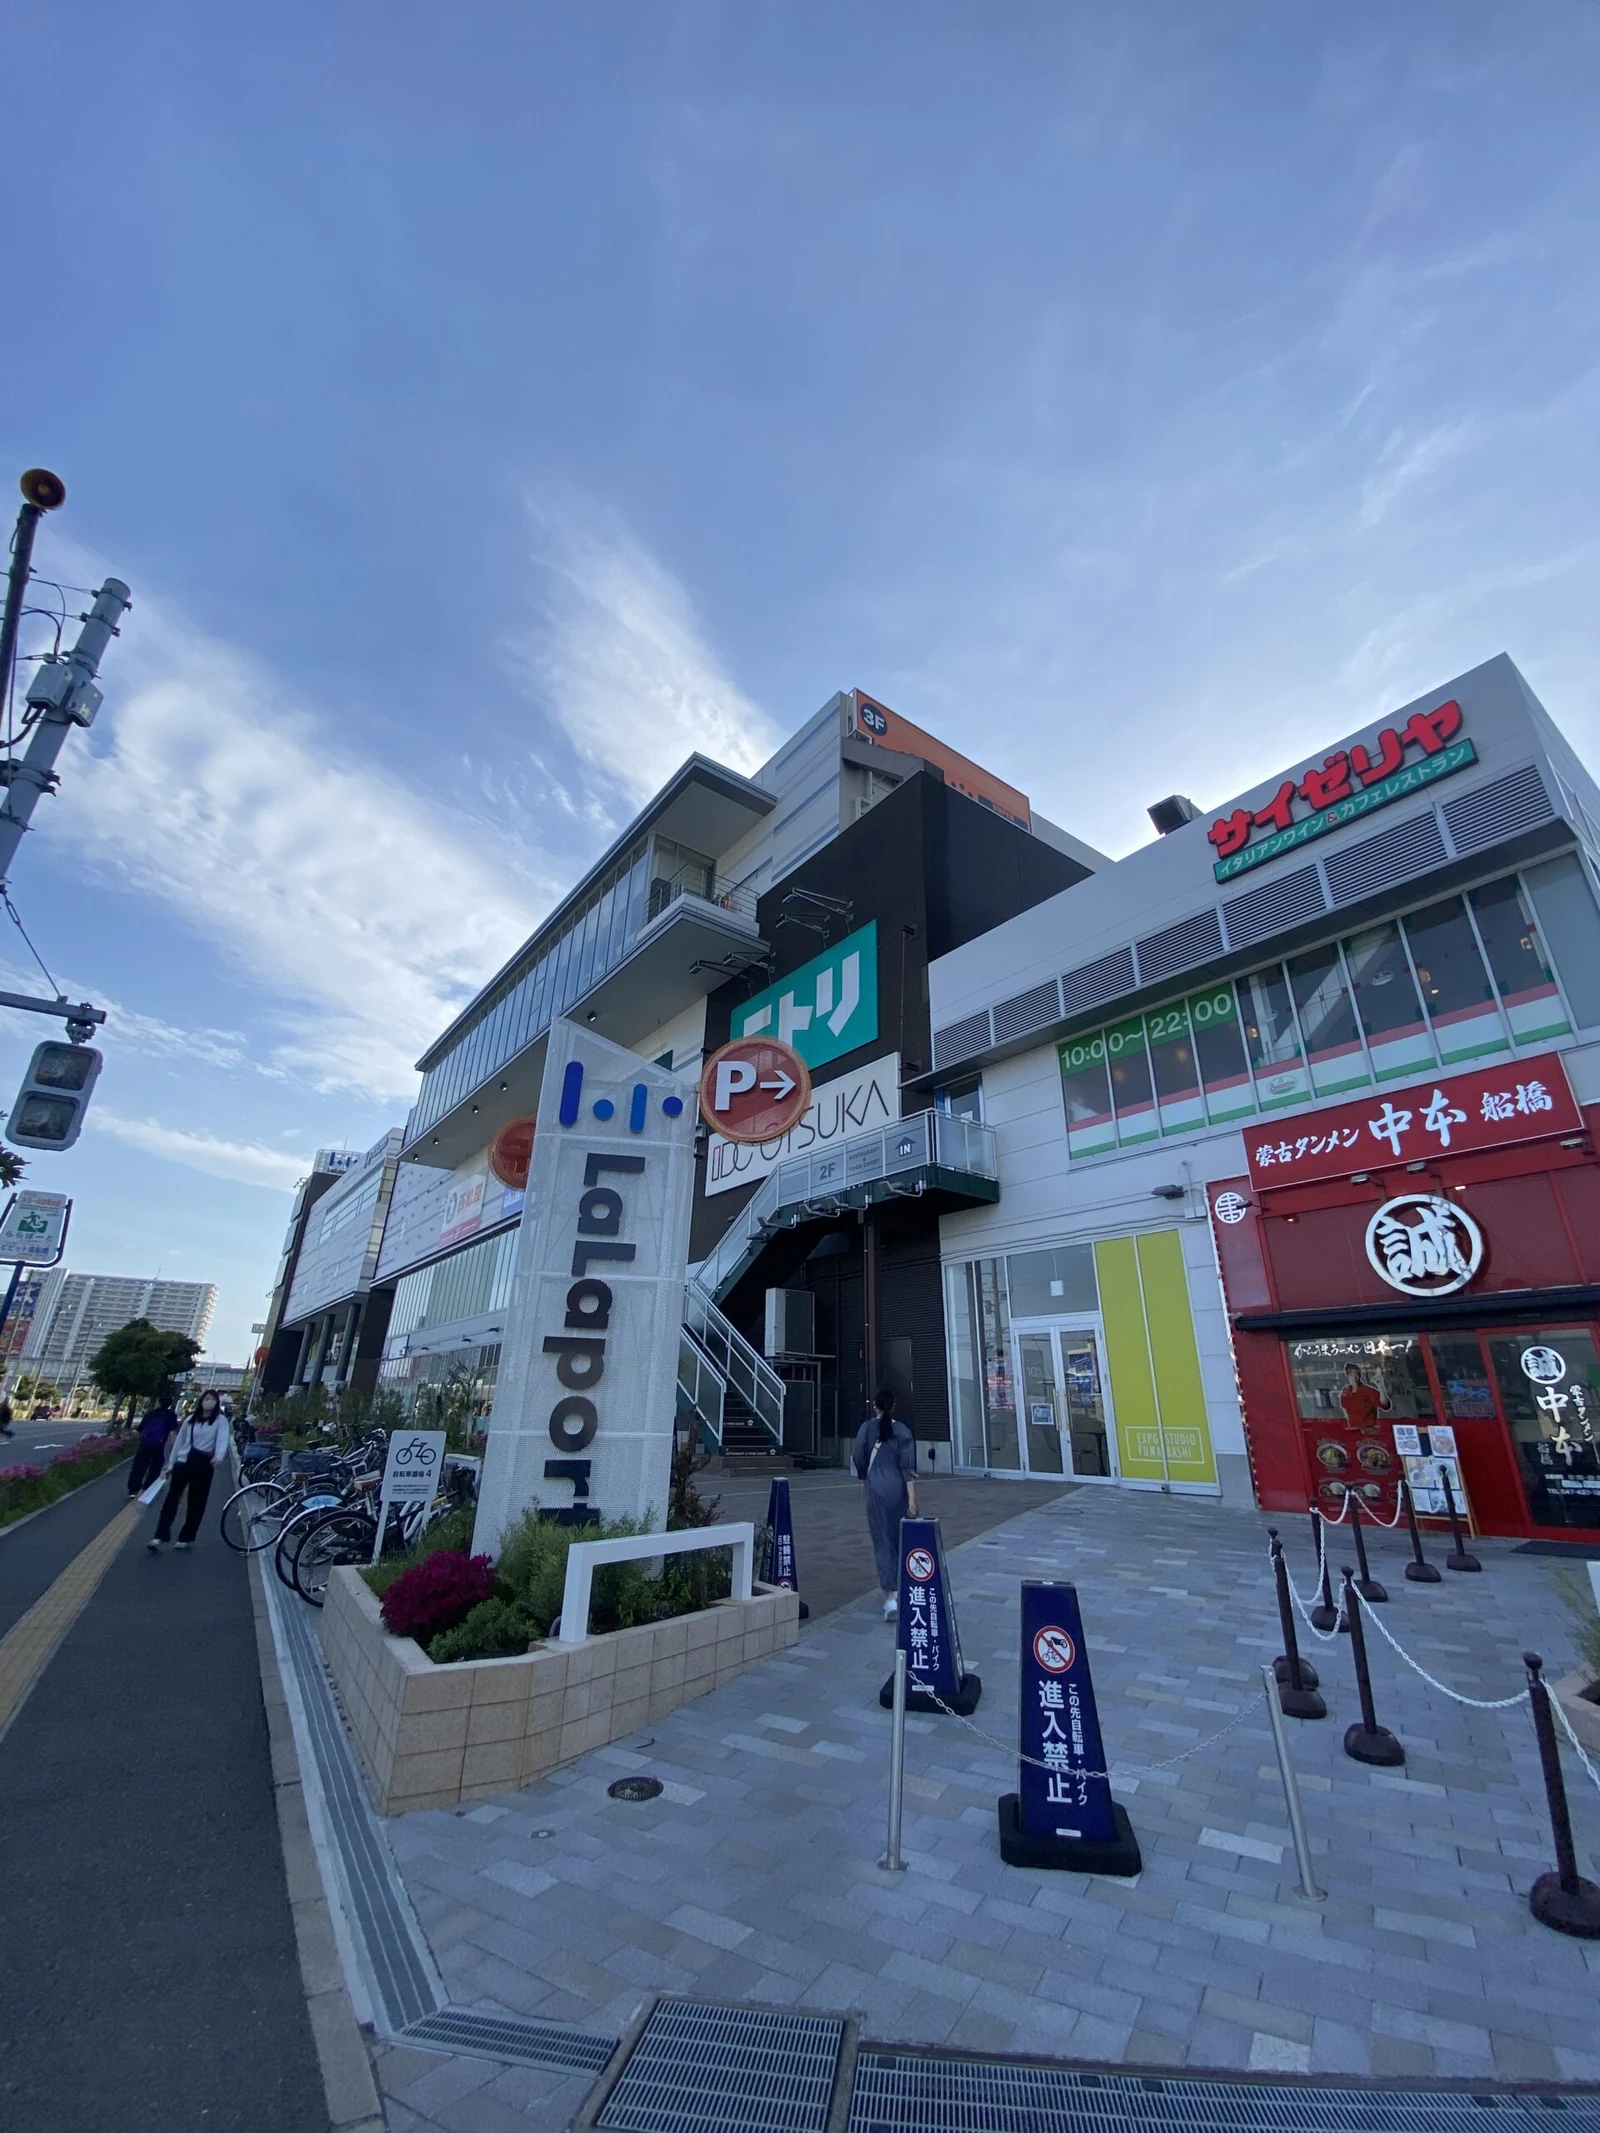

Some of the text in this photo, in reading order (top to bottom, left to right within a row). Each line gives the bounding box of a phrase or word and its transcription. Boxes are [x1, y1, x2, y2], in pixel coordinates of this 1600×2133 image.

[863, 708, 885, 730] 3F
[1208, 700, 1463, 858] サイゼリヤ
[714, 1060, 757, 1112] P
[1255, 1080, 1553, 1168] 蒙古タンメン 中本 船橋
[820, 1162, 836, 1180] 2F
[900, 1143, 911, 1156] IN
[1375, 1203, 1471, 1284] 誠
[541, 1152, 646, 1528] LaLaport
[1165, 1433, 1196, 1446] STUDIO
[1536, 1386, 1583, 1466] 中本
[782, 1534, 792, 1577] 駐輪禁止
[908, 1586, 930, 1670] 進入禁止
[928, 1587, 941, 1671] この先自転車・バイク
[1038, 1680, 1073, 1804] 進入禁止
